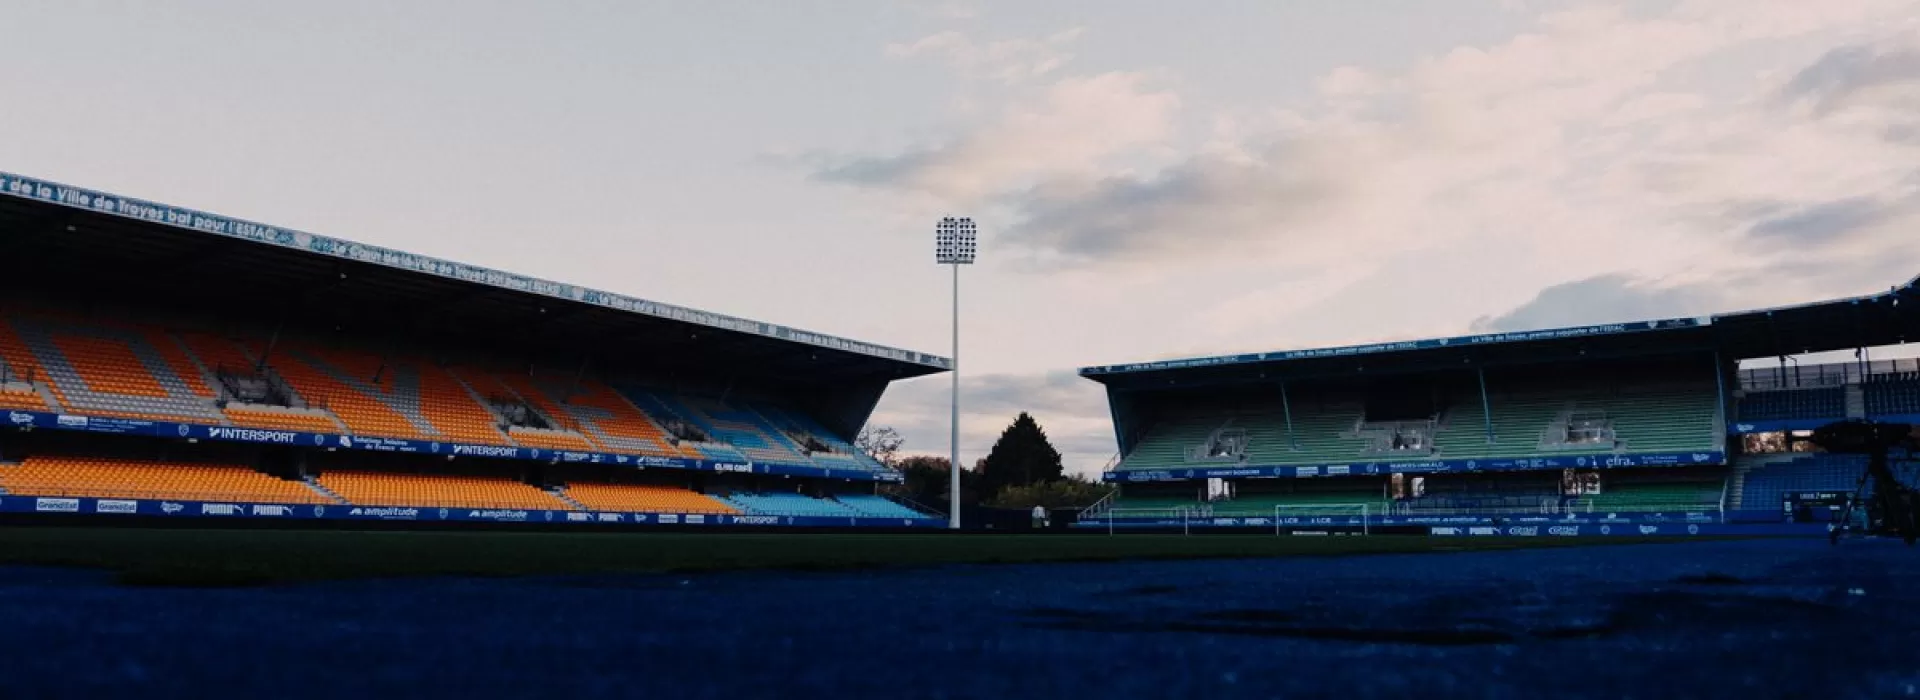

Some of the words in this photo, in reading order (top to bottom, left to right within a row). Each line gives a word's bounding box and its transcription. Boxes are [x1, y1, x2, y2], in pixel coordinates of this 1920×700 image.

[10, 178, 32, 194] de
[36, 183, 52, 199] la
[57, 187, 89, 205] Ville
[94, 196, 115, 211] de
[119, 199, 164, 220] Troyes
[194, 217, 226, 233] pour
[221, 428, 296, 443] INTERSPORT
[461, 444, 518, 457] INTERSPORT
[202, 503, 234, 515] PUMA
[252, 504, 283, 516] PUMA
[364, 506, 418, 517] amplitude
[481, 509, 527, 519] amplitude
